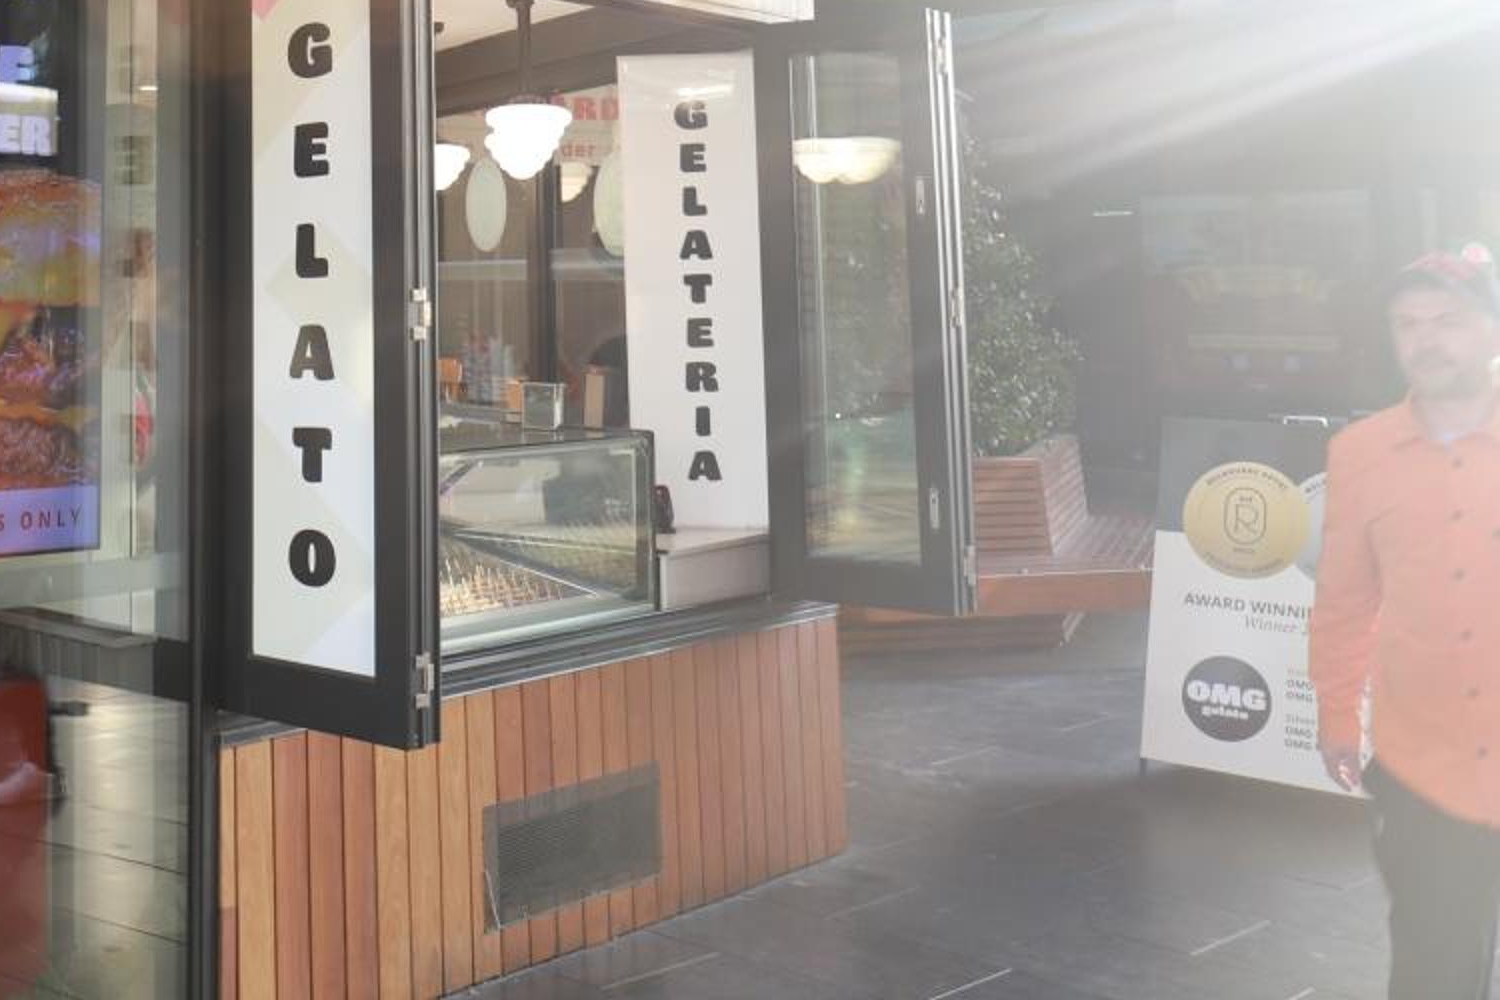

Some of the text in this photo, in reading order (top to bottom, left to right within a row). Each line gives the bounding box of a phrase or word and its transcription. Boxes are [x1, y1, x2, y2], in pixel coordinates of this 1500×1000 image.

[287, 22, 337, 587] GELATO
[673, 99, 722, 481] GELATERIA
[20, 505, 83, 531] ONLY
[1184, 593, 1312, 619] AWARD WINNI
[1186, 679, 1268, 711] OMG
